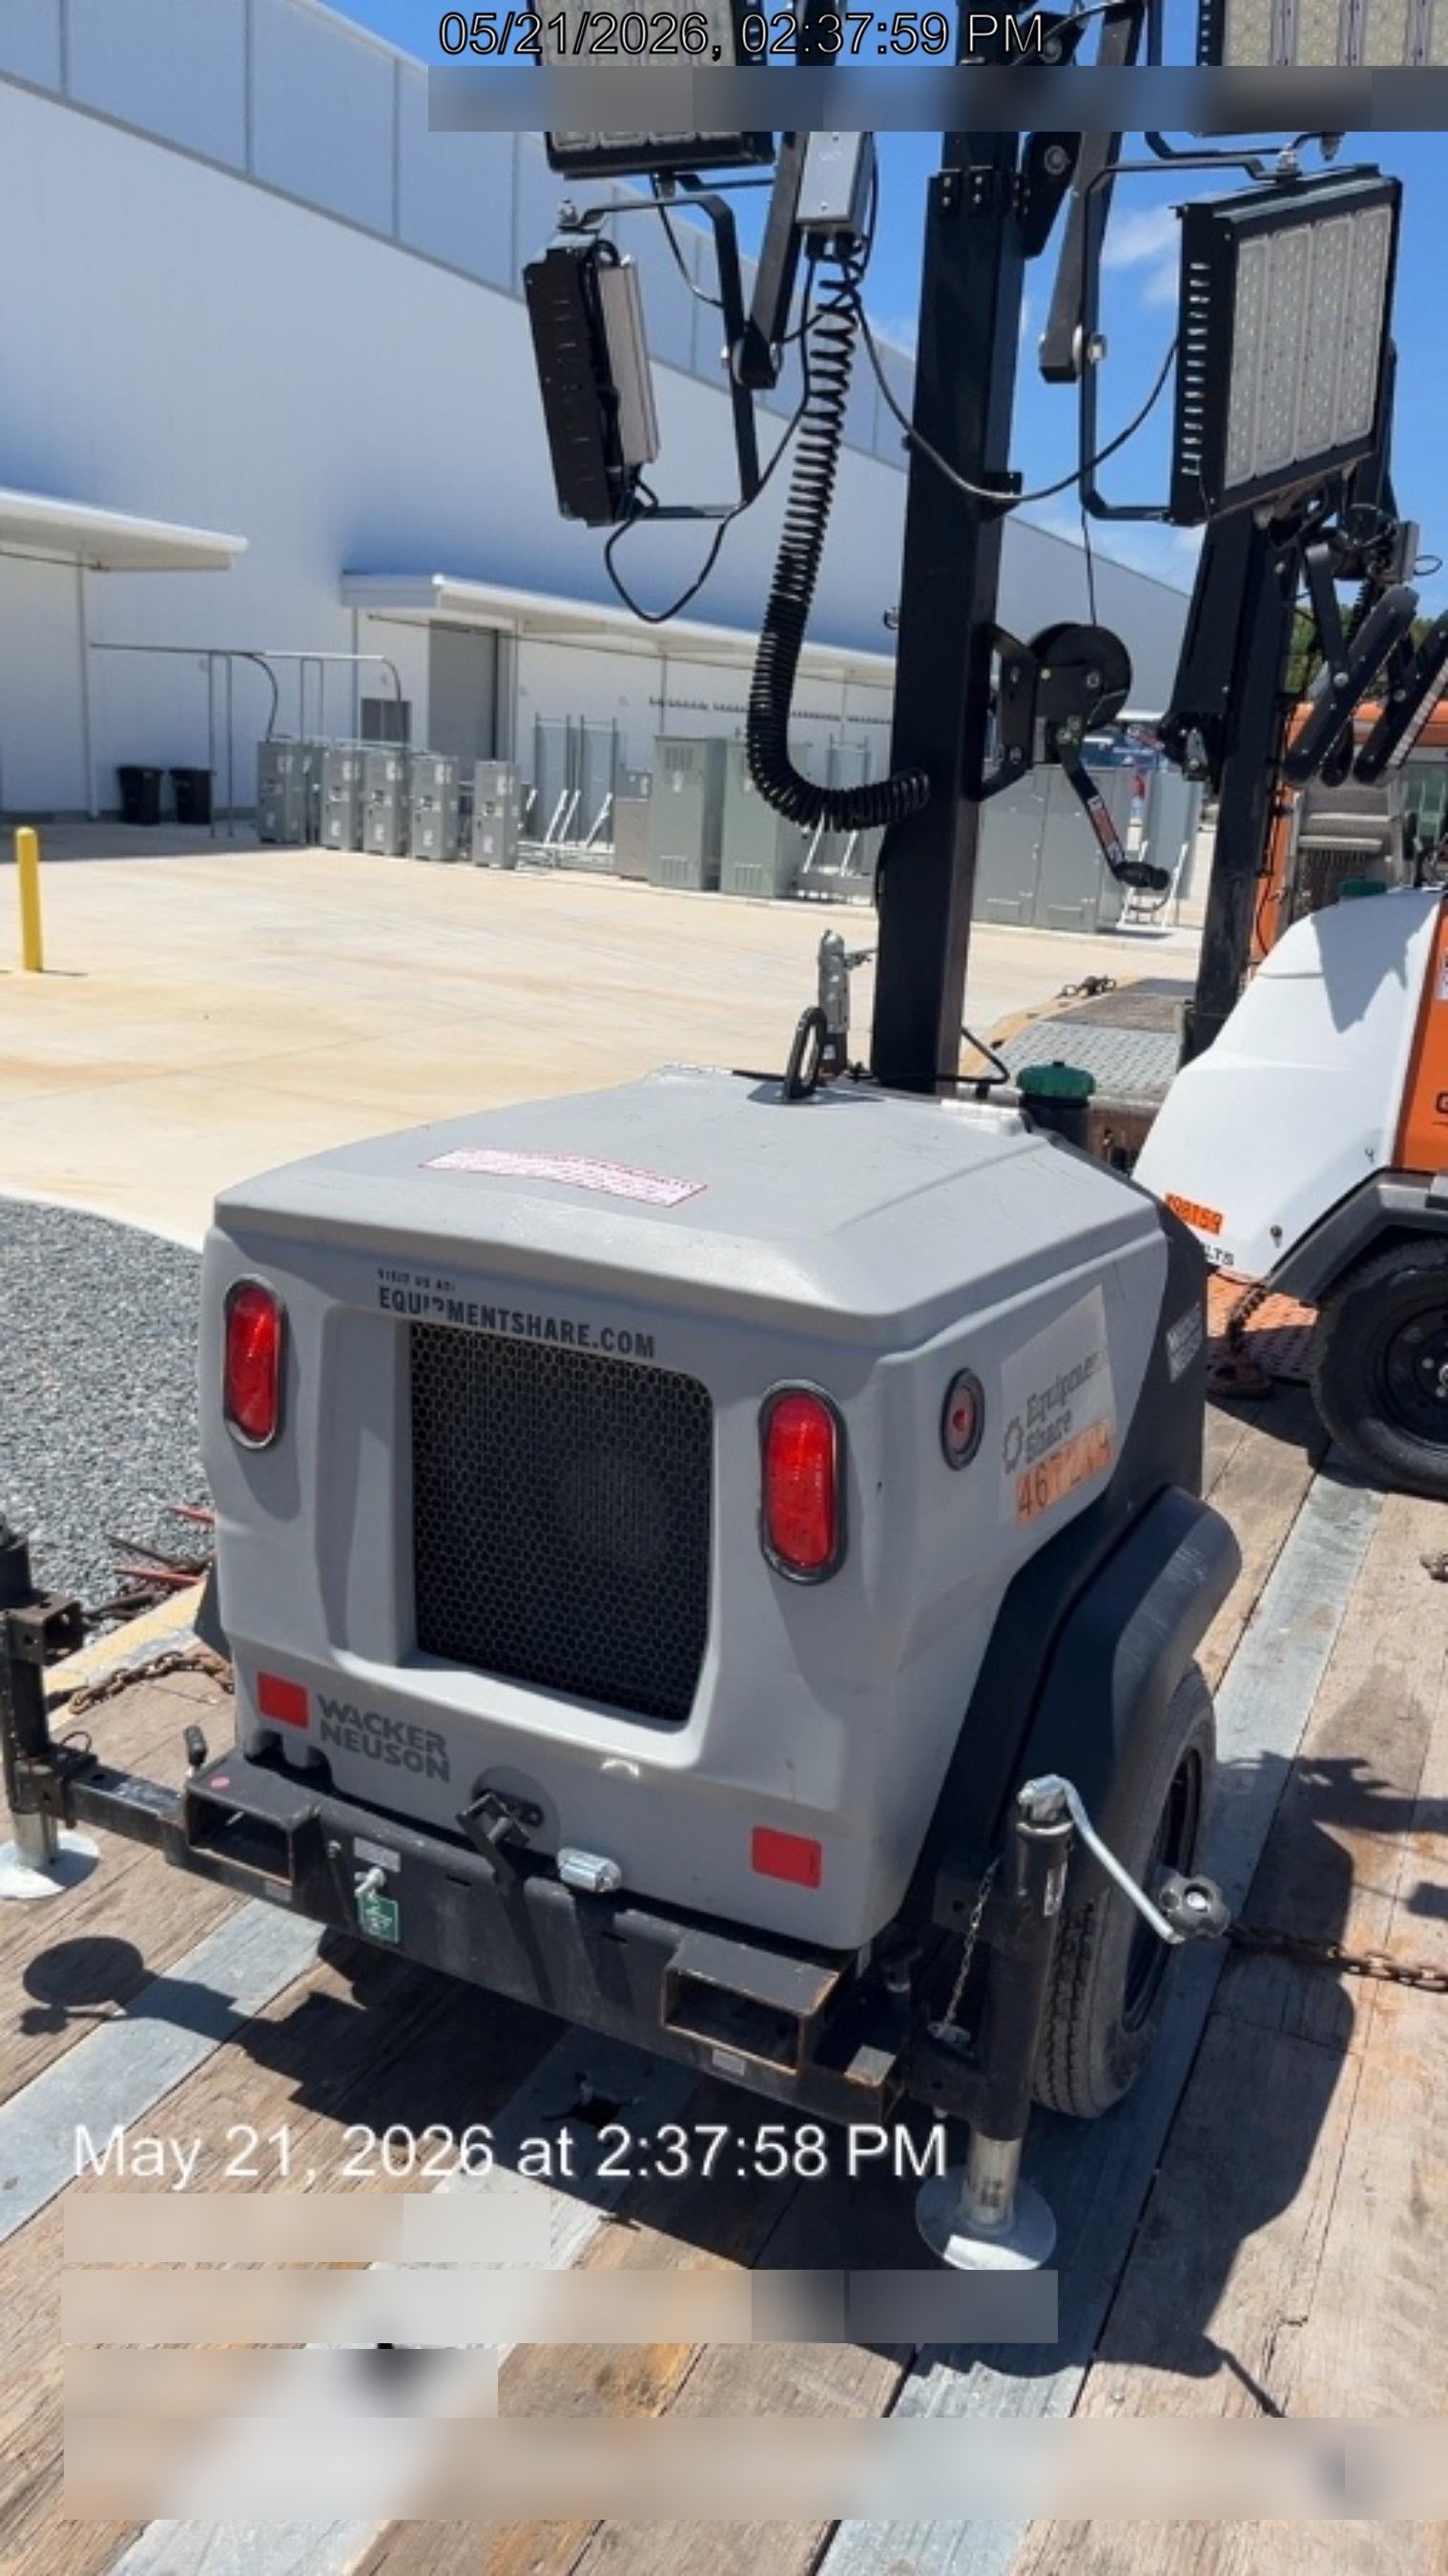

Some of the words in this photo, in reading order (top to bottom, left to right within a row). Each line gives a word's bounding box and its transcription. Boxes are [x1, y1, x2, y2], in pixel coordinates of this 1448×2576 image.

[379, 1285, 654, 1359] EQUIPMENTSHARE.COM
[317, 1693, 447, 1758] WACKER
[320, 1719, 451, 1784] NEUSON
